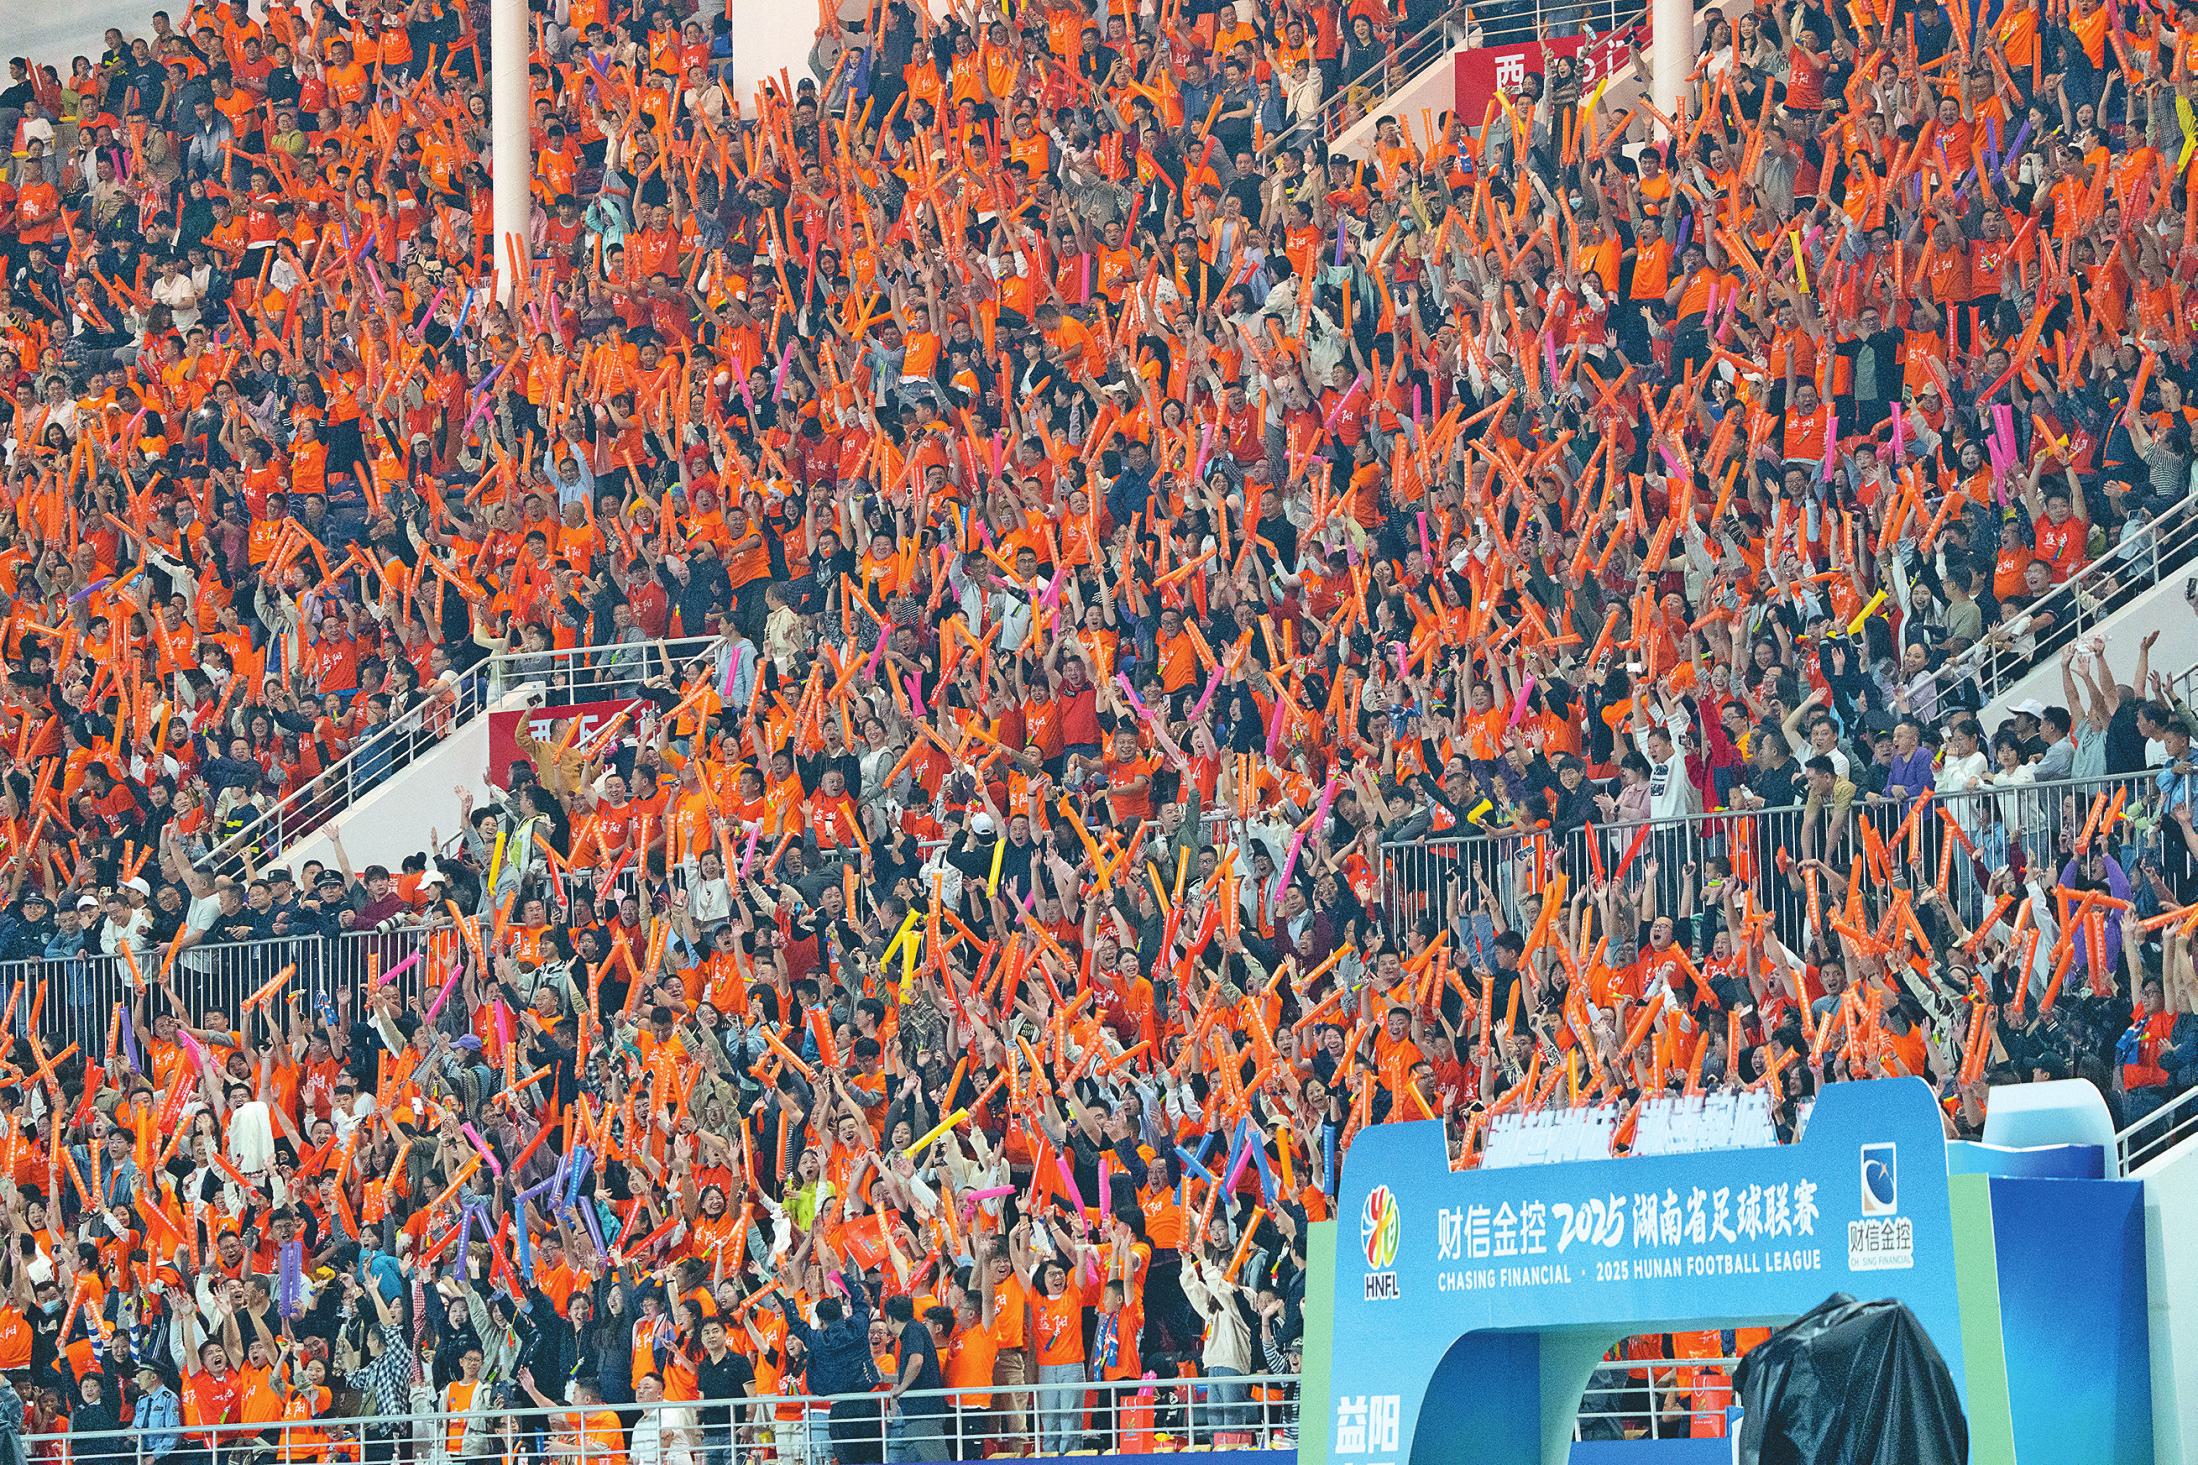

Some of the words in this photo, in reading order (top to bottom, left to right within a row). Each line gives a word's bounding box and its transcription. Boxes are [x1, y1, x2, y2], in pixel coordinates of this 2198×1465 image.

[1437, 1199, 1547, 1262] 财信金控
[1551, 1192, 1627, 1254] 2025
[1633, 1178, 1820, 1248] 湖南省足球联赛
[1850, 1222, 1912, 1253] 财信金控
[1366, 1274, 1399, 1298] HNFL
[1437, 1269, 1496, 1292] CHASING
[1501, 1264, 1572, 1288] FINANCIAL
[1596, 1260, 1629, 1281] 2025
[1633, 1257, 1682, 1280] HUNAN
[1687, 1252, 1760, 1276] FOOTBALL
[1765, 1249, 1822, 1273] LEAGUE
[1335, 1394, 1401, 1454] 益阳
